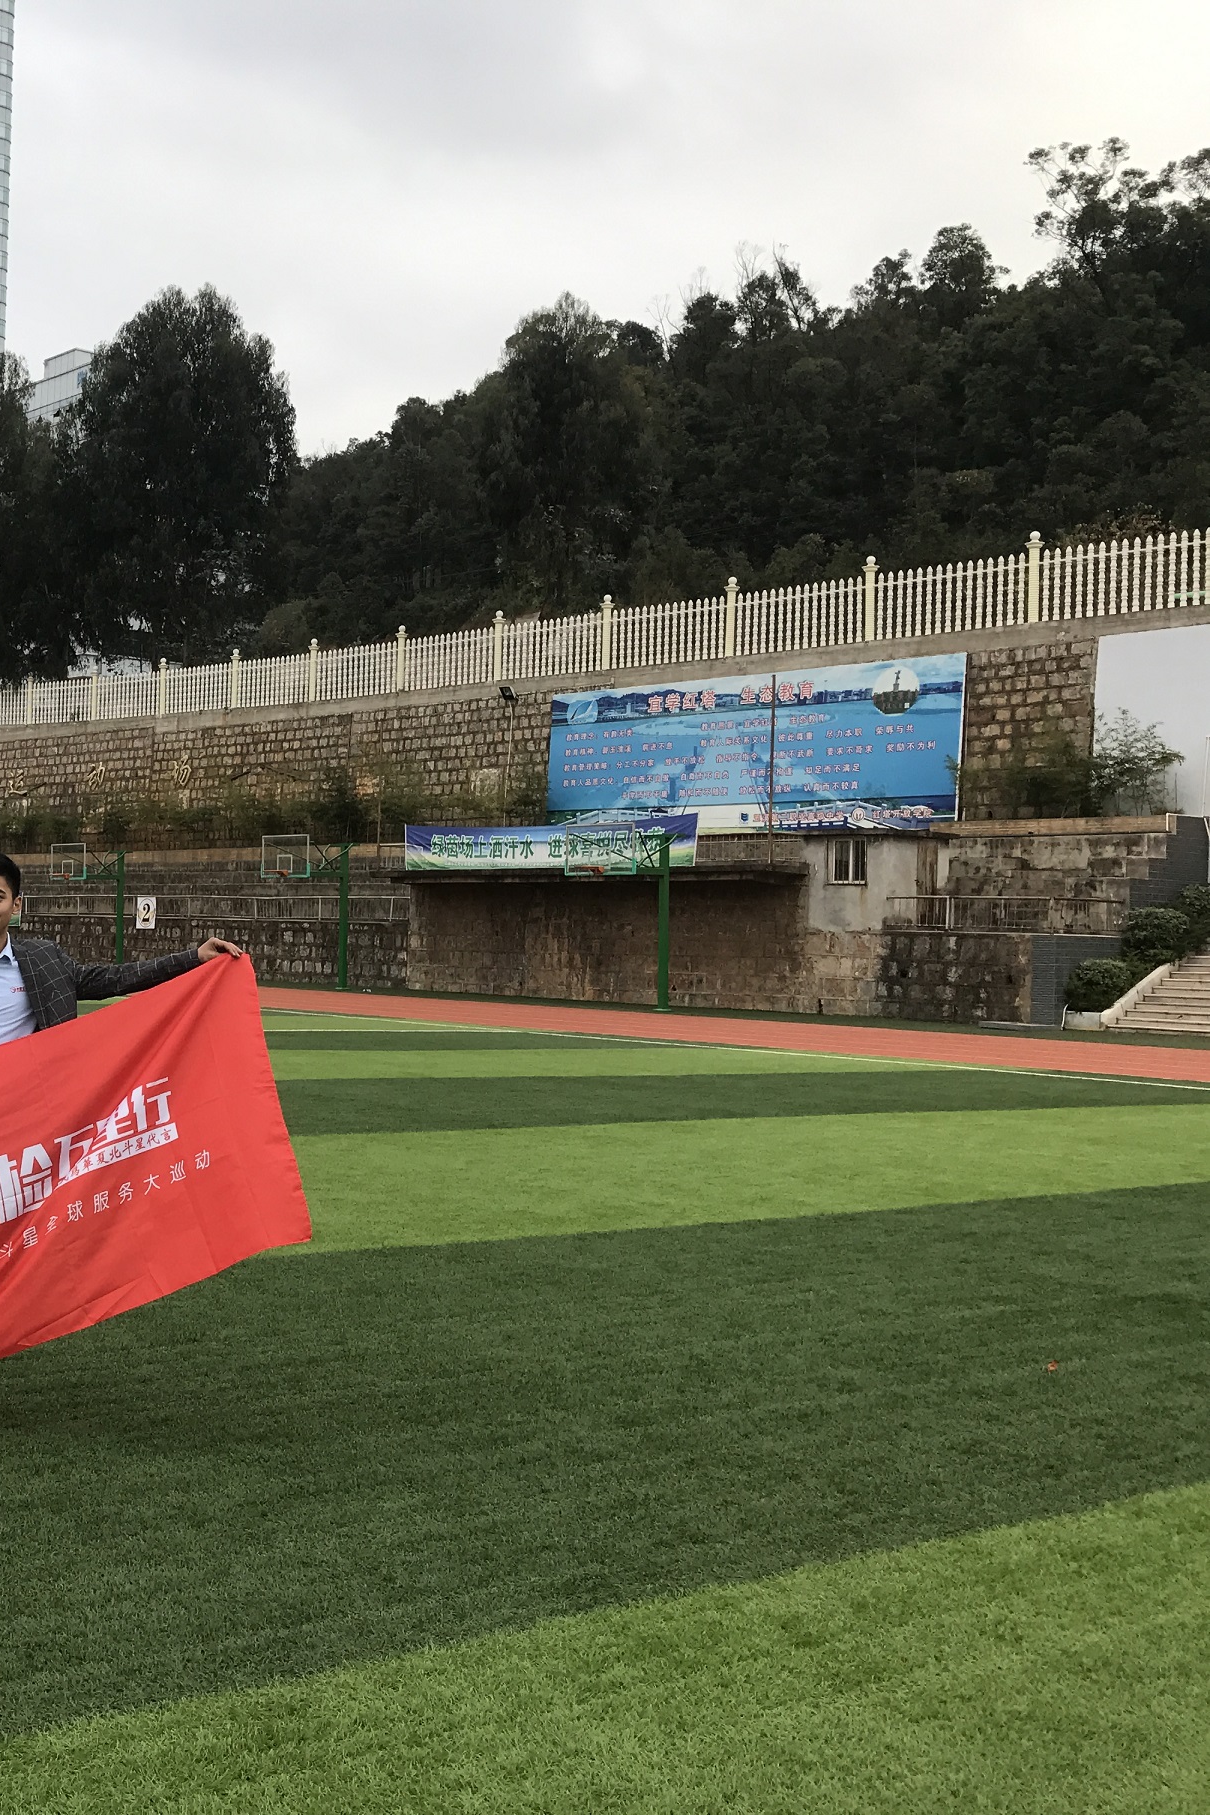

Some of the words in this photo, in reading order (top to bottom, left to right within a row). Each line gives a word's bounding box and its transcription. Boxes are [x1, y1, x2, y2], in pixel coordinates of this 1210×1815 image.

[648, 690, 716, 713] 宜学红塔
[740, 681, 815, 704] 生态教育
[790, 713, 826, 725] 生态教育
[875, 724, 915, 736] 荣辱与共
[431, 834, 534, 859] 绿茵场上洒汗水
[141, 903, 151, 923] 2
